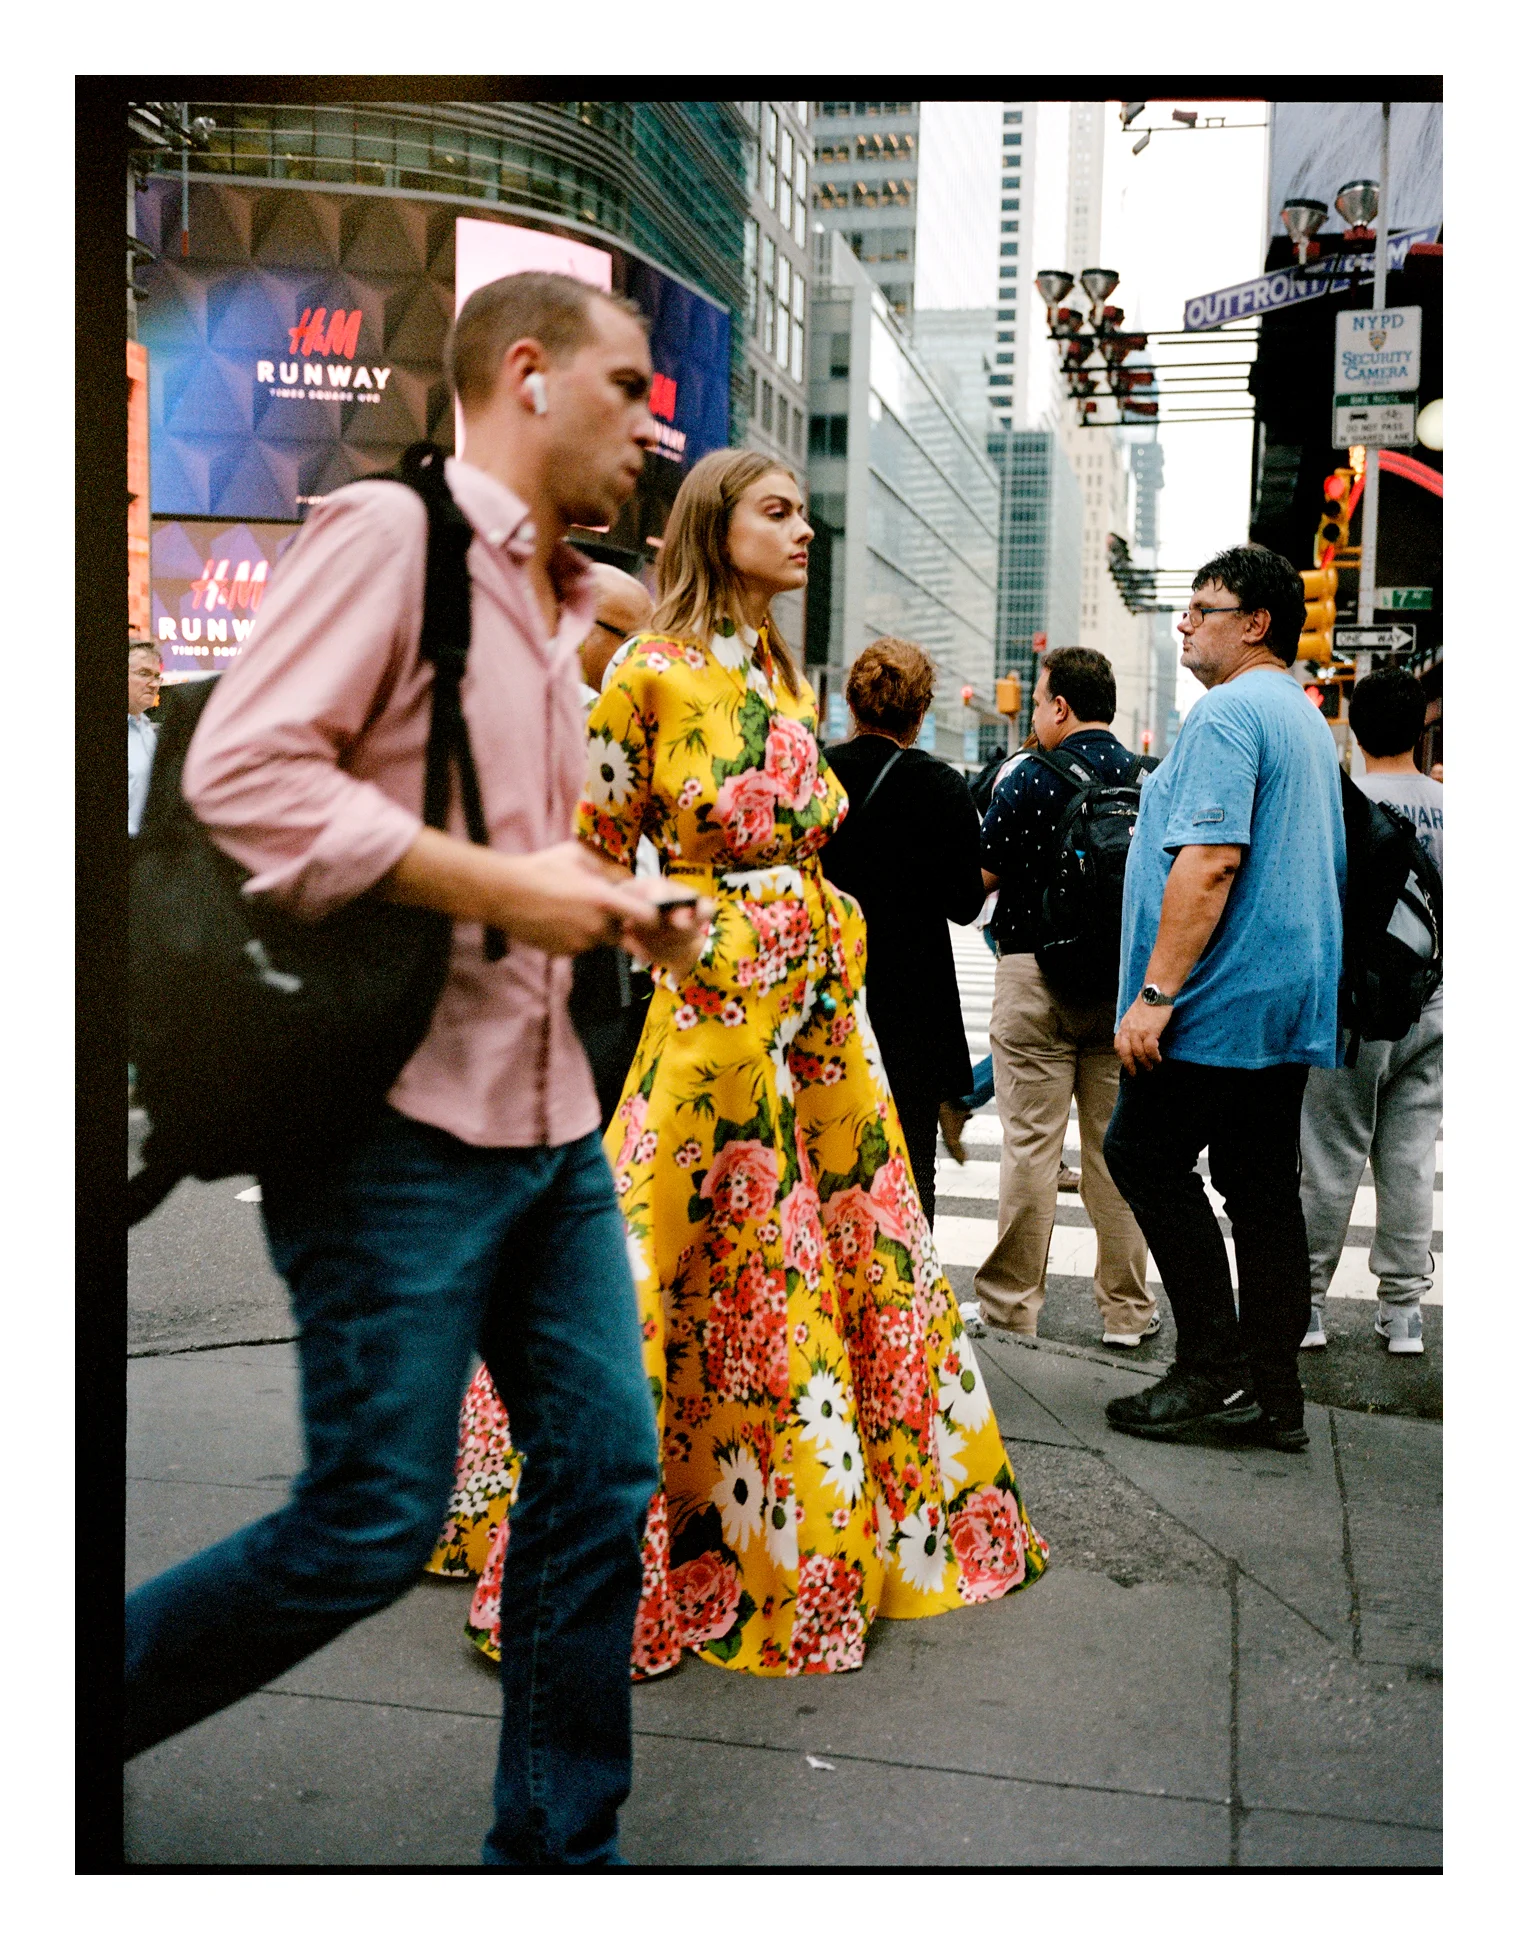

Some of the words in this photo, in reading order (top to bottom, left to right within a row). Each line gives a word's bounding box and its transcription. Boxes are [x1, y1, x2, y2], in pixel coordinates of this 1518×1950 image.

[1186, 261, 1327, 327] OUTFRONT
[288, 307, 363, 360] H&M
[1353, 314, 1405, 331] NYPD
[1342, 350, 1412, 366] SECURITY
[256, 360, 391, 390] RUNWAY
[1344, 366, 1408, 381] CAMERA
[190, 558, 269, 613] H&M
[1337, 632, 1361, 646] ONE
[1377, 632, 1402, 644] WAY
